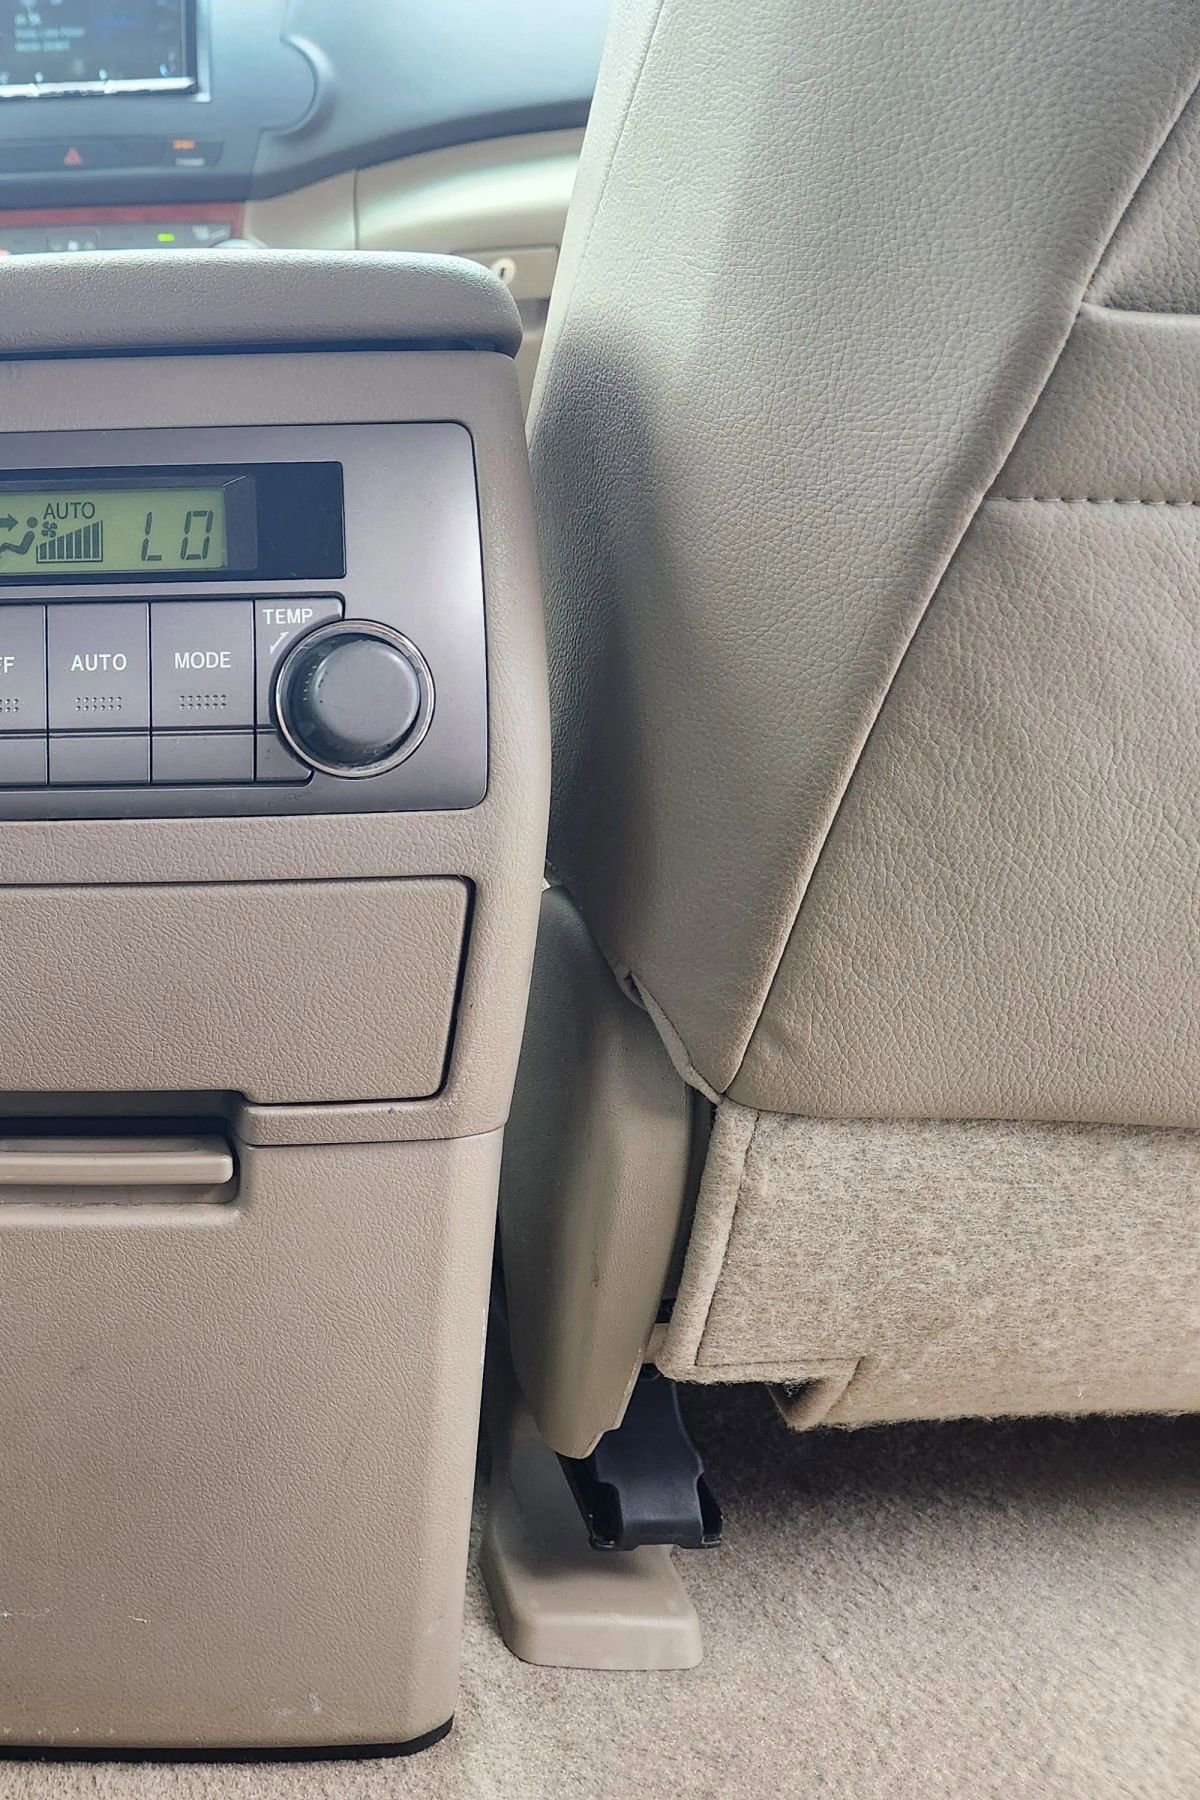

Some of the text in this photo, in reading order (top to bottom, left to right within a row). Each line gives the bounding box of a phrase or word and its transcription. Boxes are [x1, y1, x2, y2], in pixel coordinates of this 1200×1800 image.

[43, 501, 96, 520] AUTO
[262, 607, 313, 625] TEMP
[70, 653, 128, 672] AUTO
[174, 651, 232, 670] MODE
